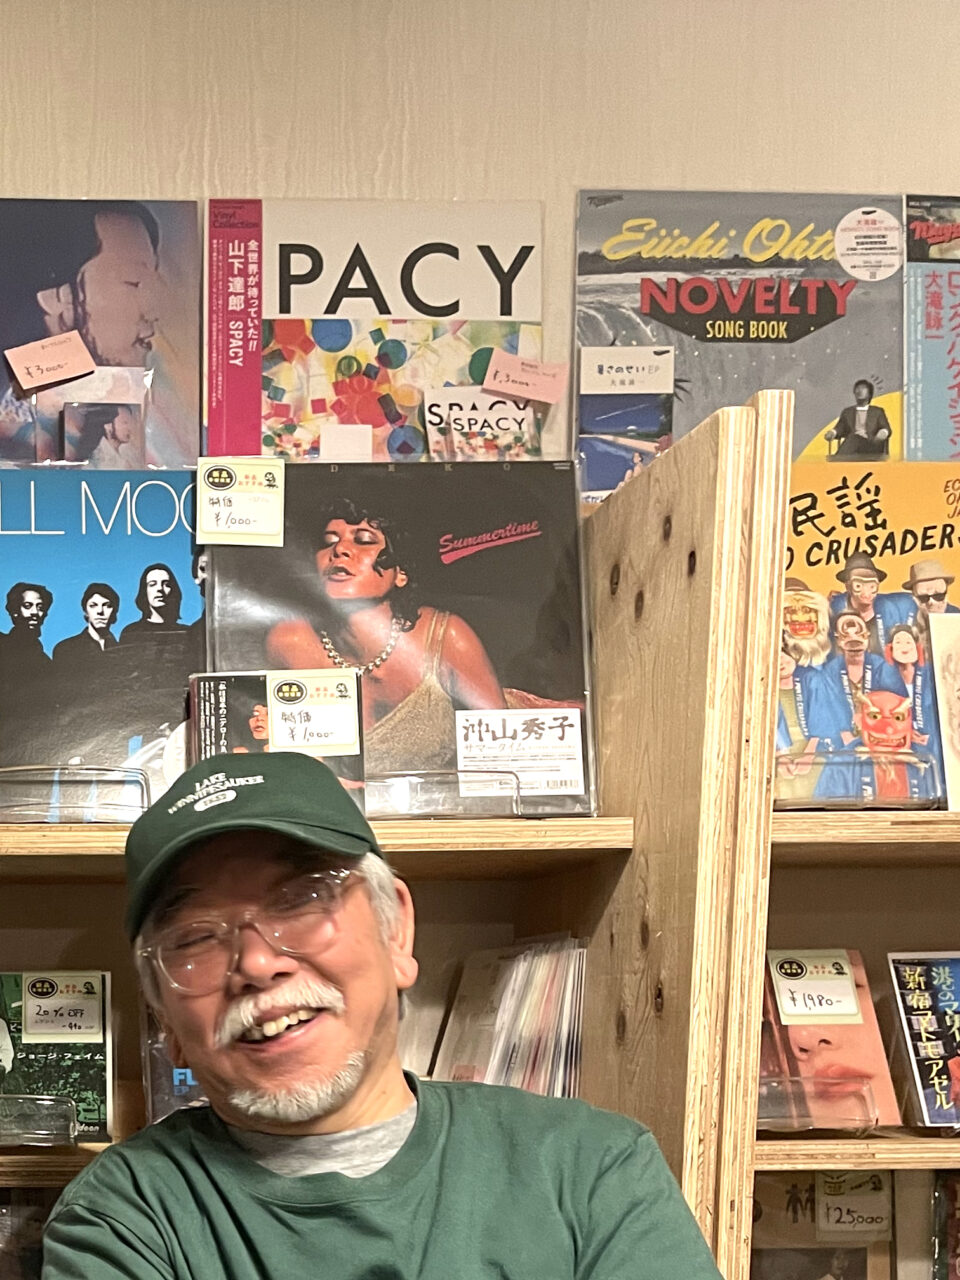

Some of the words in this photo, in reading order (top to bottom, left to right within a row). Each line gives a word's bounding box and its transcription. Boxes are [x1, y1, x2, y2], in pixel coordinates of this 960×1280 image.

[601, 218, 737, 260] Eiichi
[228, 241, 244, 311] 山下達郎
[640, 277, 858, 315] NOVELTY
[229, 321, 244, 367] SPACY
[706, 320, 744, 338] SONG
[749, 320, 788, 338] BOOK
[453, 418, 525, 431] SPACY
[790, 471, 888, 537] 民謡
[440, 519, 539, 553] Summertime
[805, 524, 960, 567] CRUSADER
[462, 716, 575, 742] 沖山秀子
[195, 773, 226, 791] LAKE
[17, 1052, 104, 1060] ジョージ・フェイム
[903, 967, 954, 1110] 新宿マドモアゼル
